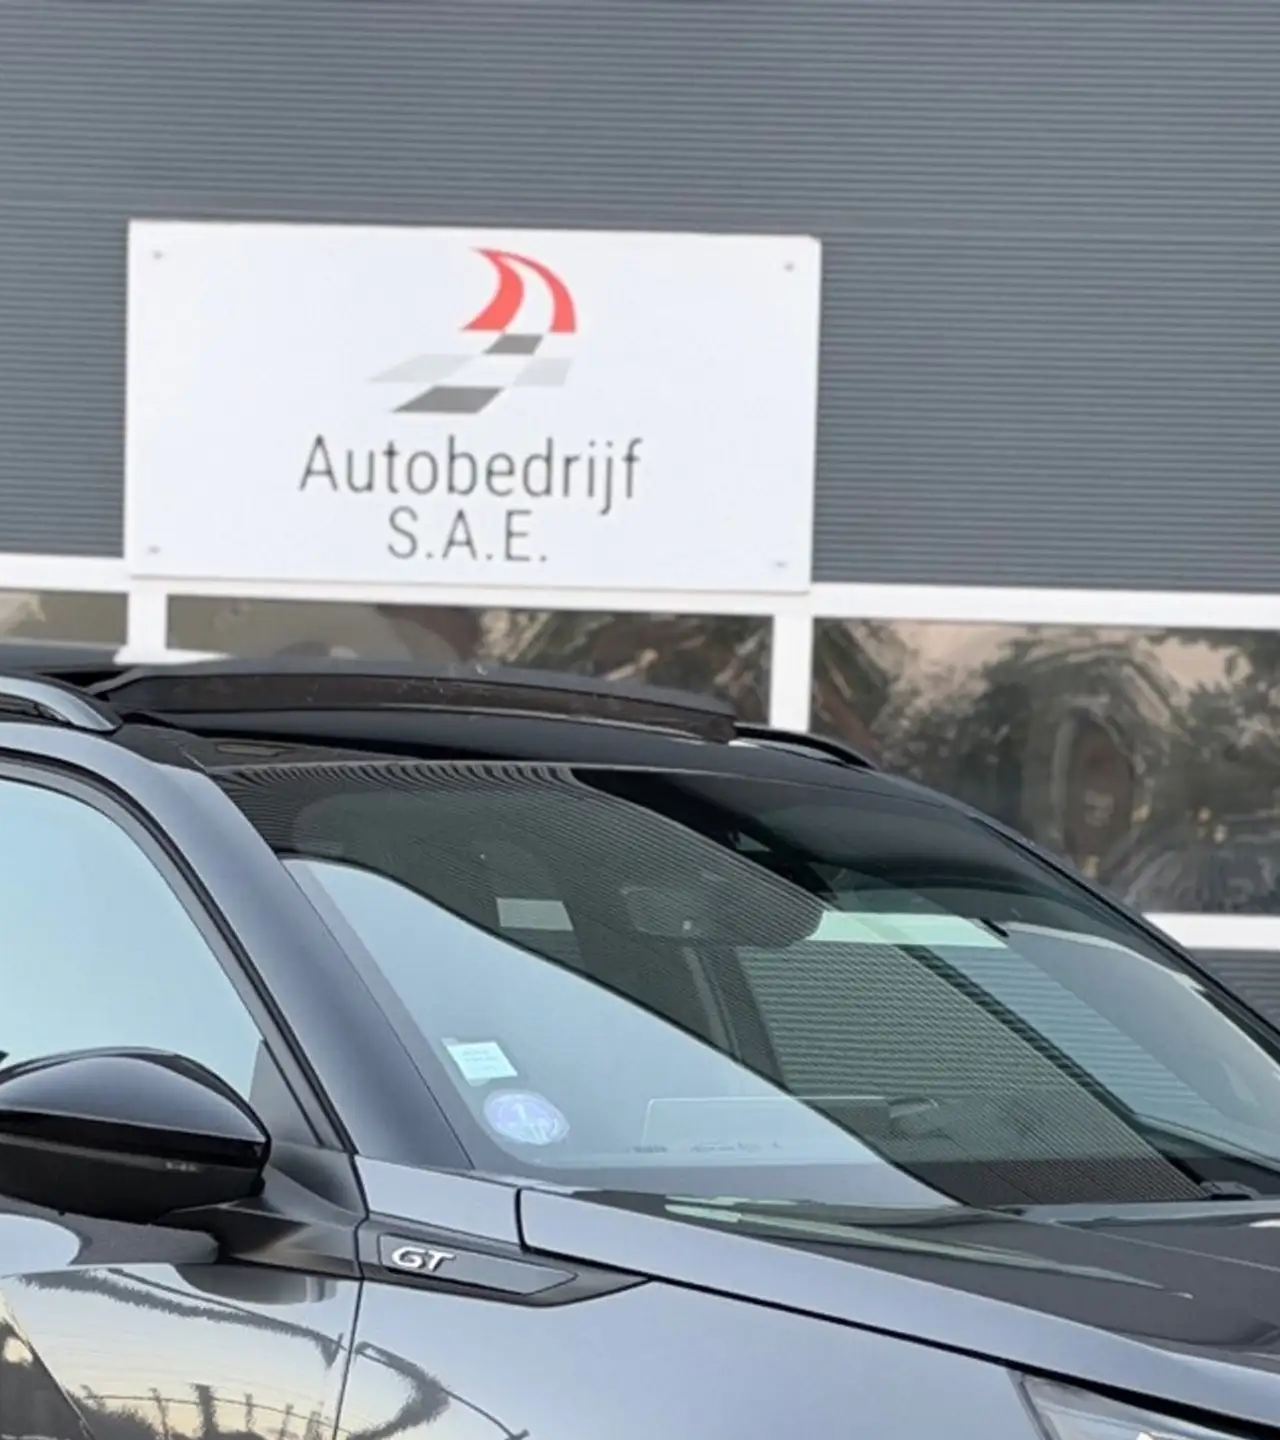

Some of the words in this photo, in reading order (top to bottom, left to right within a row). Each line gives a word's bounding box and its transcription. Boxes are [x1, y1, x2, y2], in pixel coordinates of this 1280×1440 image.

[299, 433, 644, 516] Autobedrijf
[387, 505, 547, 563] S.A.E.
[391, 1246, 456, 1271] GT
